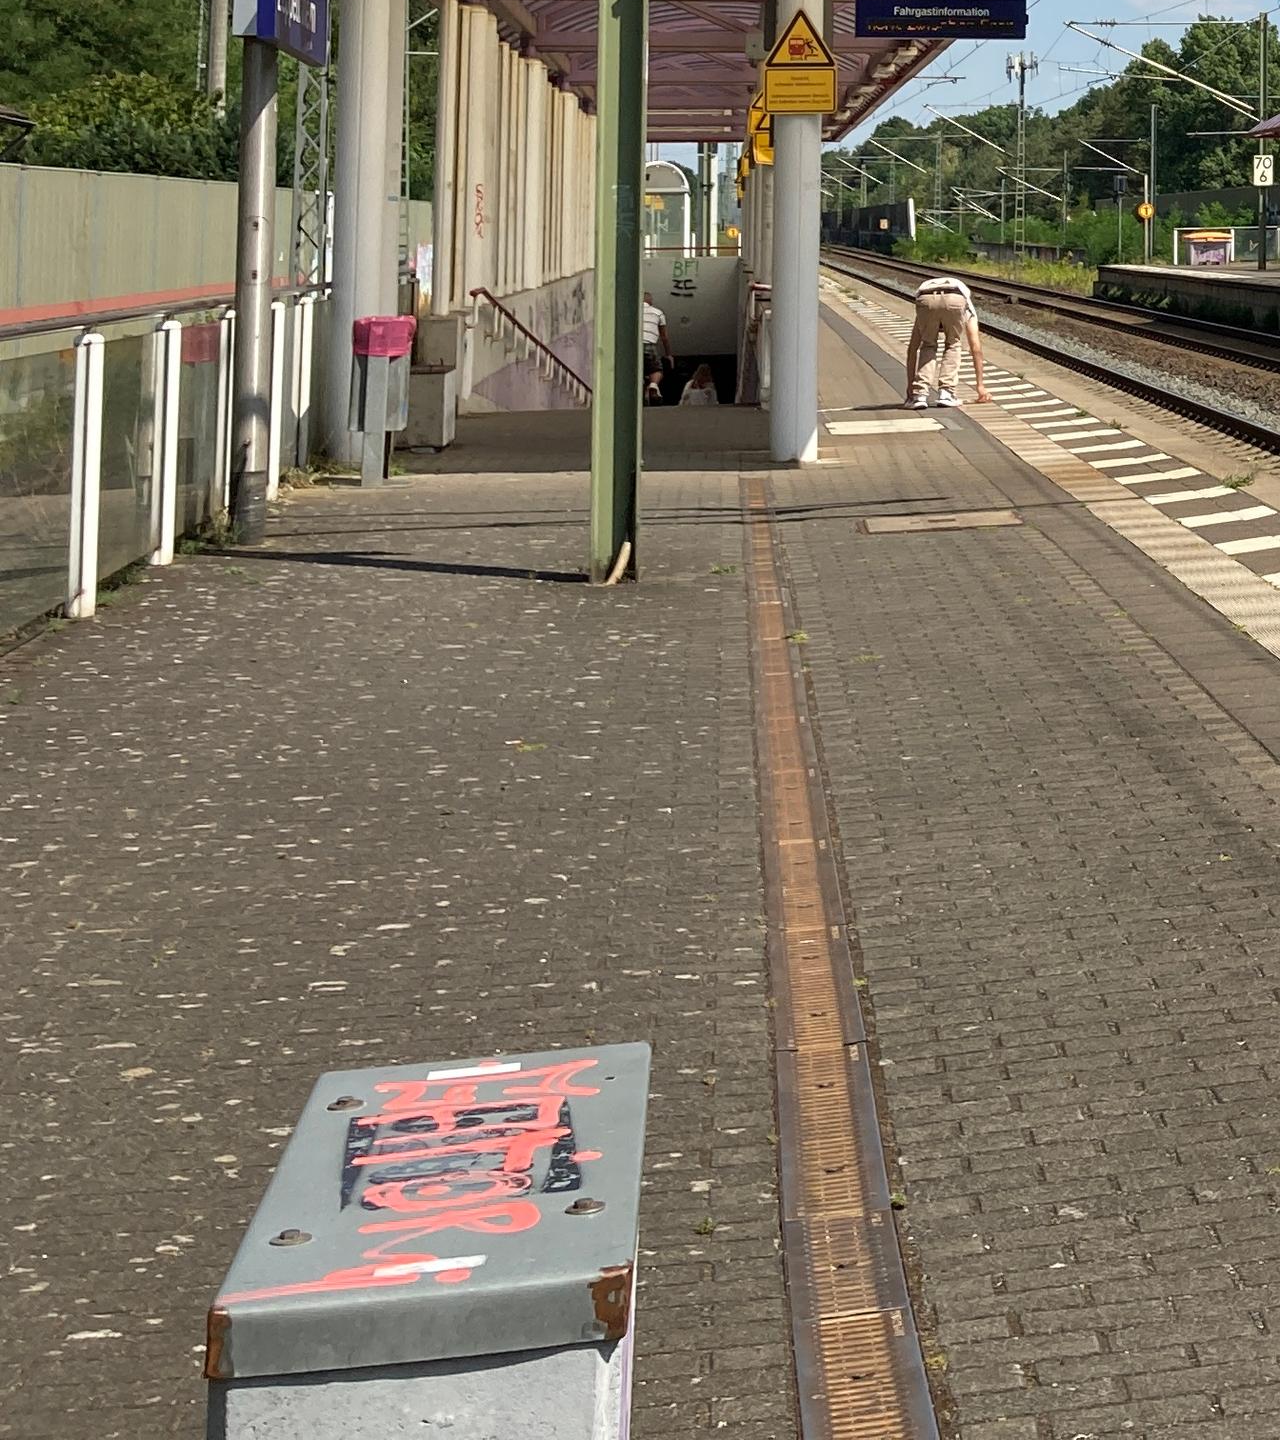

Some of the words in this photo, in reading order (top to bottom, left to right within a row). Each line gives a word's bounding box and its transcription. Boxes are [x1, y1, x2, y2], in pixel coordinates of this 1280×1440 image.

[893, 6, 990, 18] Fahrgastinformation
[1254, 156, 1272, 169] 70
[1259, 170, 1268, 182] 6
